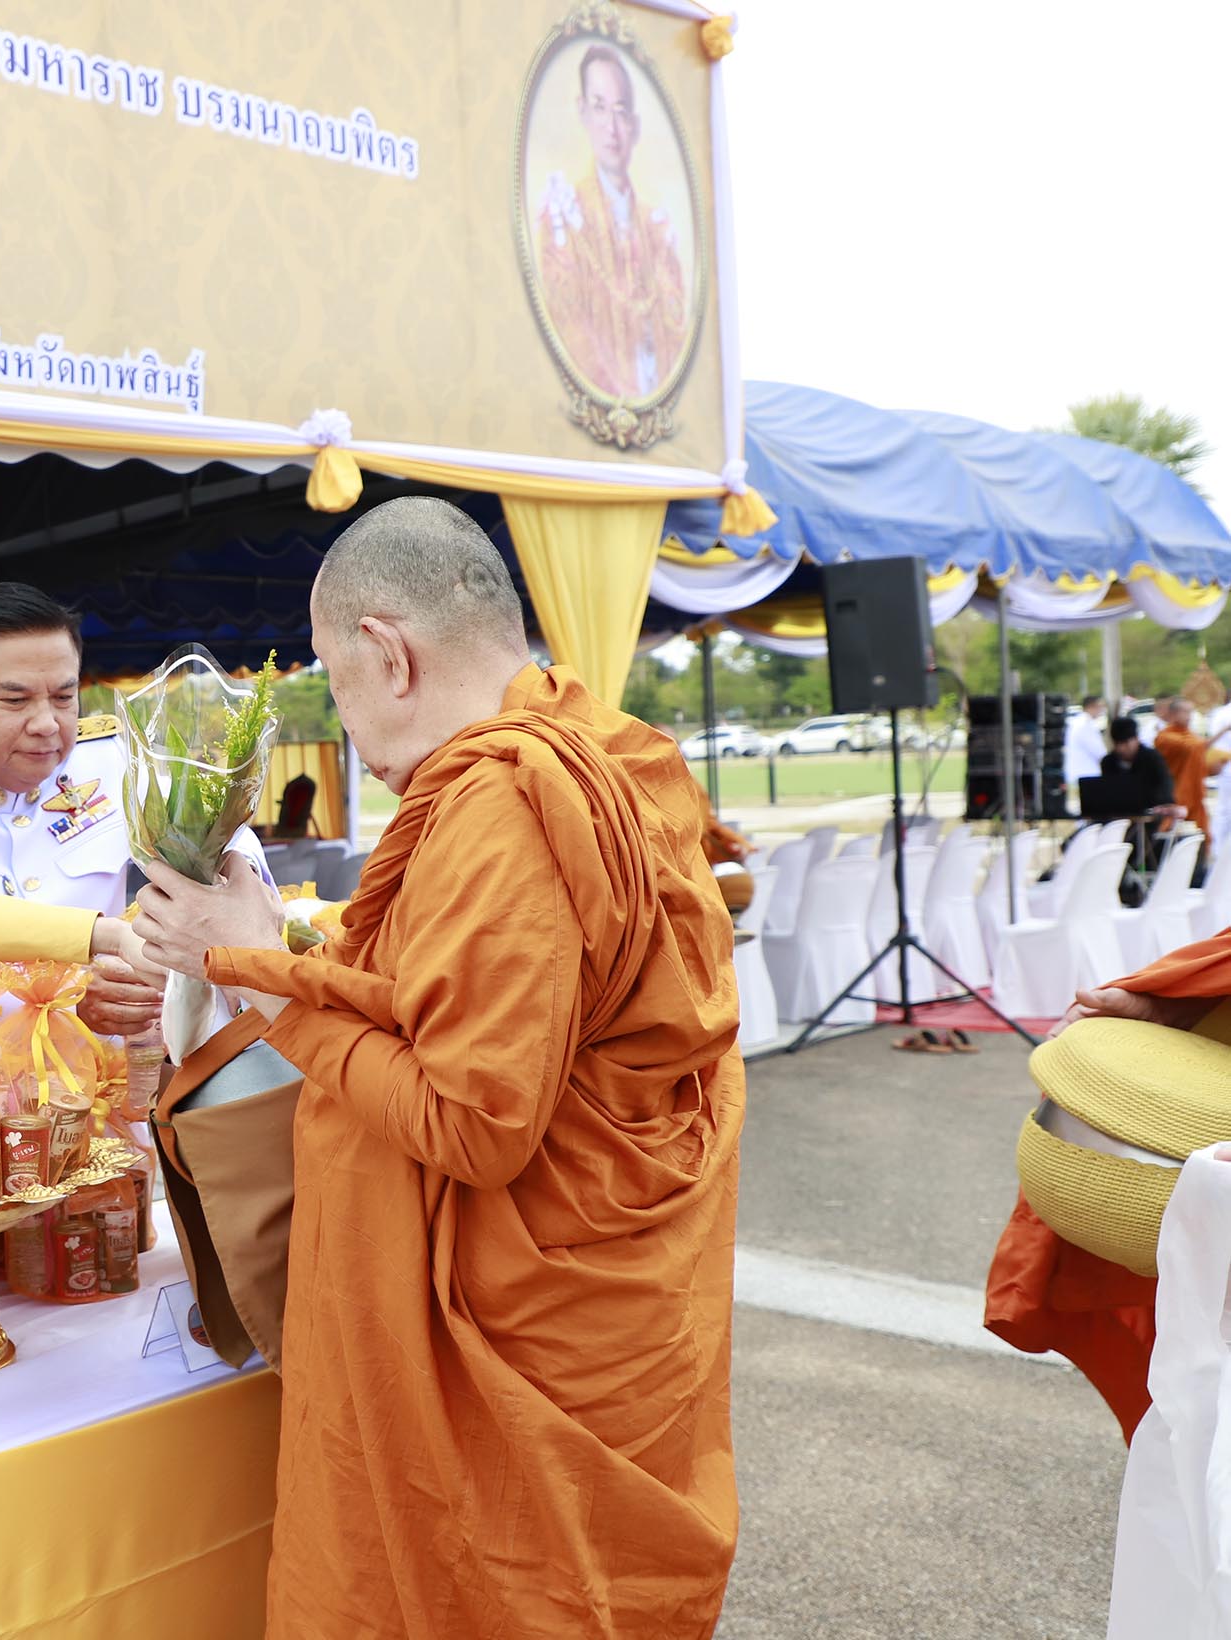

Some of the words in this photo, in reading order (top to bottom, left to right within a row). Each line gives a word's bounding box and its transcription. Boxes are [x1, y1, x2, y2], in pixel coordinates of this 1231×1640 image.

[178, 82, 417, 173] บรมนาถบพิตร
